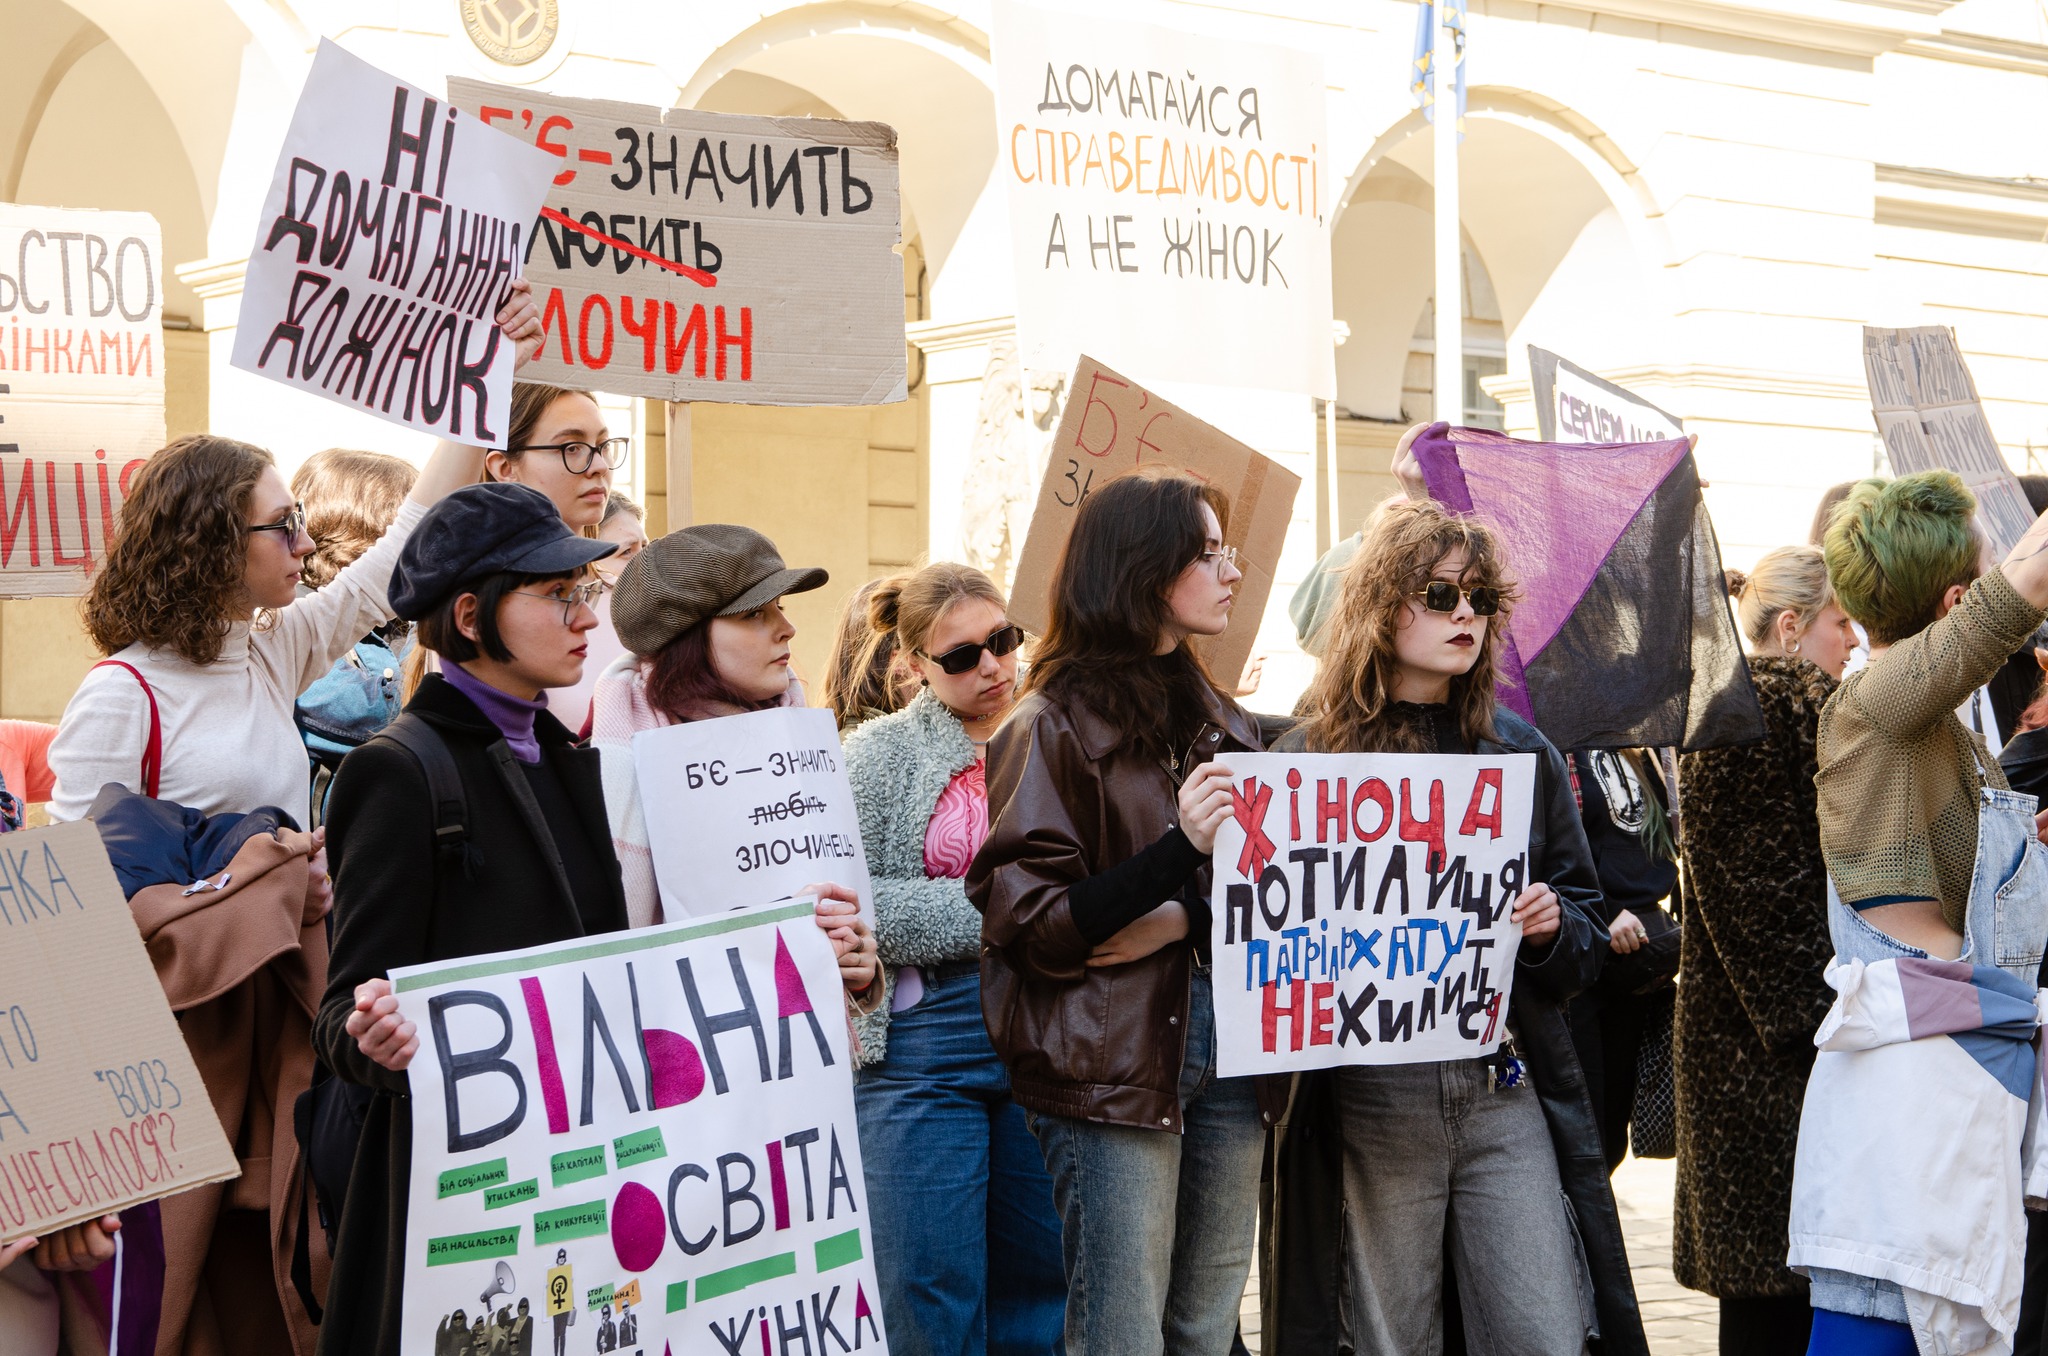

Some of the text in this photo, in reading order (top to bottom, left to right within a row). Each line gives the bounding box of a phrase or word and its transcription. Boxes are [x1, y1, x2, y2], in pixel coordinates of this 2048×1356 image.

[1037, 62, 1262, 141] ДОМАГАЙСЯ
[524, 207, 723, 276] ЛЮБИТЬ
[1045, 208, 1289, 289] А НЕ ЖІНОК
[531, 287, 752, 382] ЛОЧИН
[0, 448, 147, 579] ИЦІ
[686, 759, 729, 789] Б'Є
[768, 749, 836, 777] ЗНАЧИТЬ
[736, 834, 855, 872] ЗЛОЧИНЕЦЬ
[1231, 768, 1503, 883] ЖІНОЧА
[1225, 844, 1526, 945] ПОТИЛИЦЯ
[428, 925, 835, 1154] ВІЛЬНА
[486, 1185, 536, 1204] УТИСКАНЬ
[611, 1123, 857, 1272] ОСВІТА
[450, 1234, 515, 1251] НАСИЛЬСТВА
[708, 1278, 880, 1356] ЖІНКА
